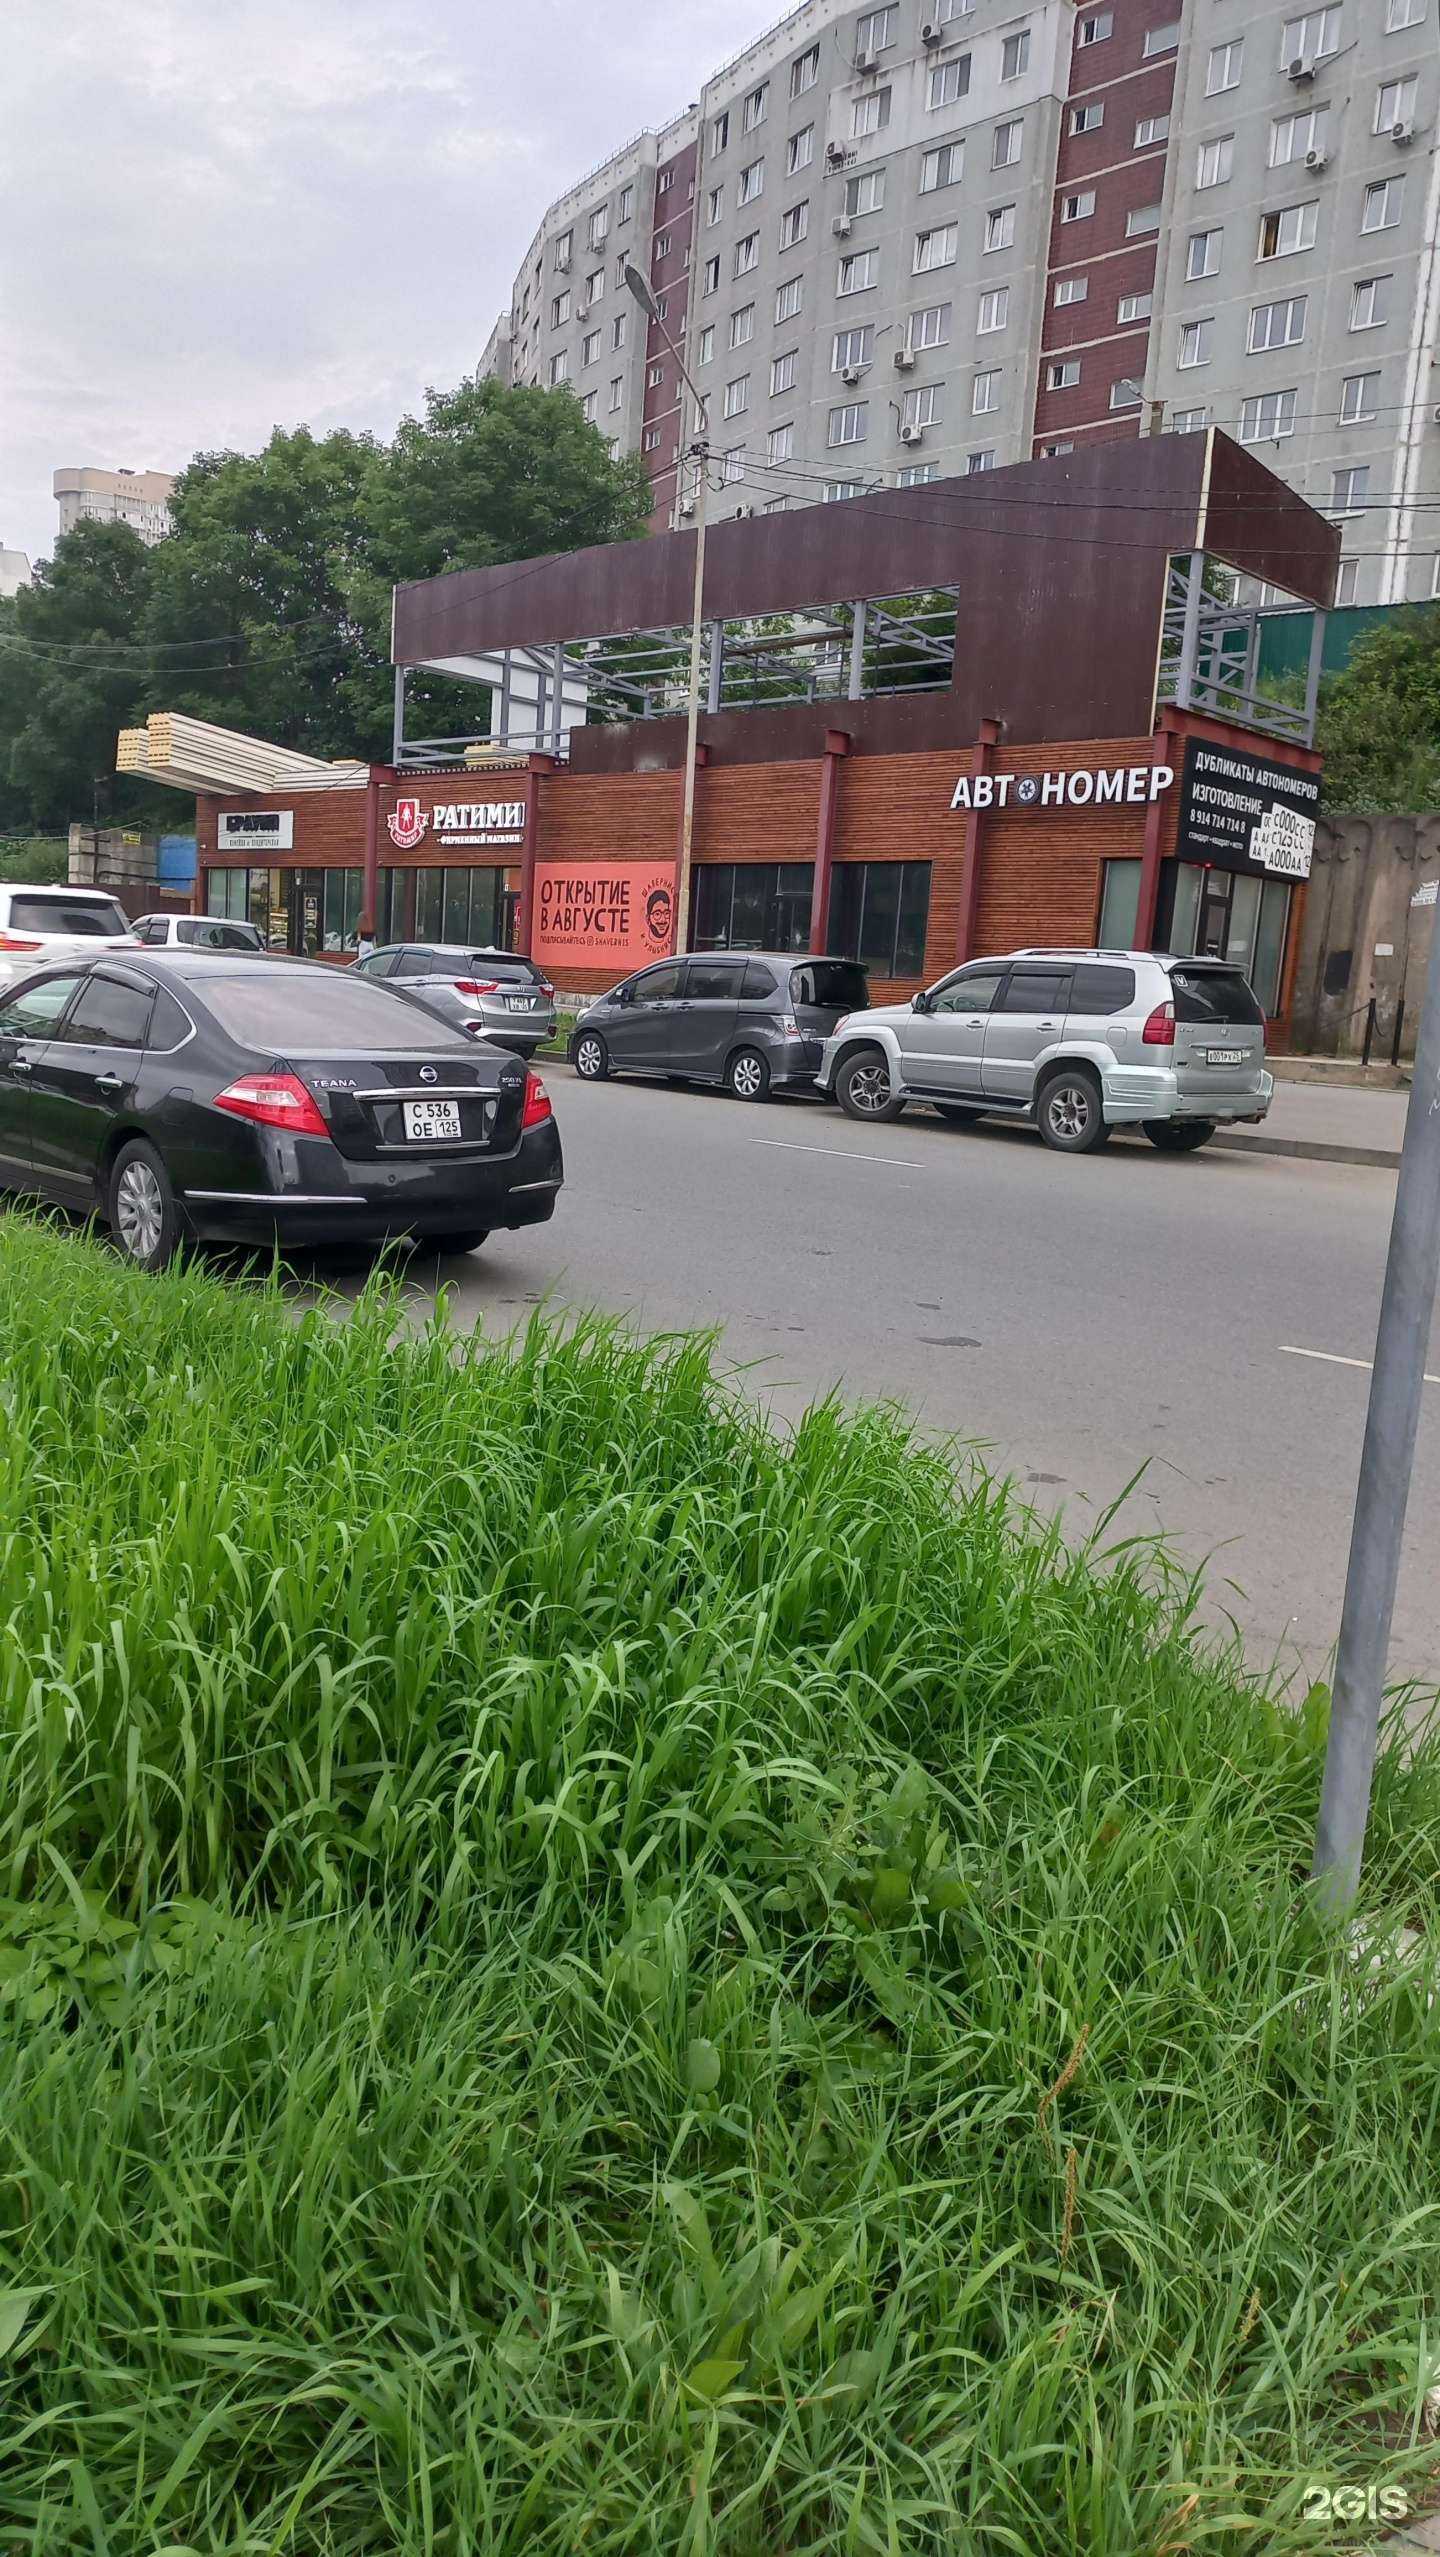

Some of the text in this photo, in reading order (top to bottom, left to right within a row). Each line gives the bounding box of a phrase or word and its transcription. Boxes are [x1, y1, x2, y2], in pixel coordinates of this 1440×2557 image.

[1195, 752, 1318, 800] ДУБЛИКАТЫ АВТОНОМЕРОВ
[1192, 782, 1263, 815] ИЗГОТОВЛЕНИЕ
[432, 802, 525, 830] РАТИМИ
[1190, 809, 1195, 822] 8
[1196, 811, 1211, 825] 914
[1211, 814, 1226, 829] 714
[1226, 817, 1240, 832] 714
[541, 880, 630, 905] ОТКРЫТИЕ
[541, 907, 549, 931] В
[552, 907, 630, 933] АВГУСТЕ
[311, 1079, 357, 1088] TEANA
[413, 1103, 451, 1118] С 536
[413, 1121, 458, 1137] ОЕ 125
